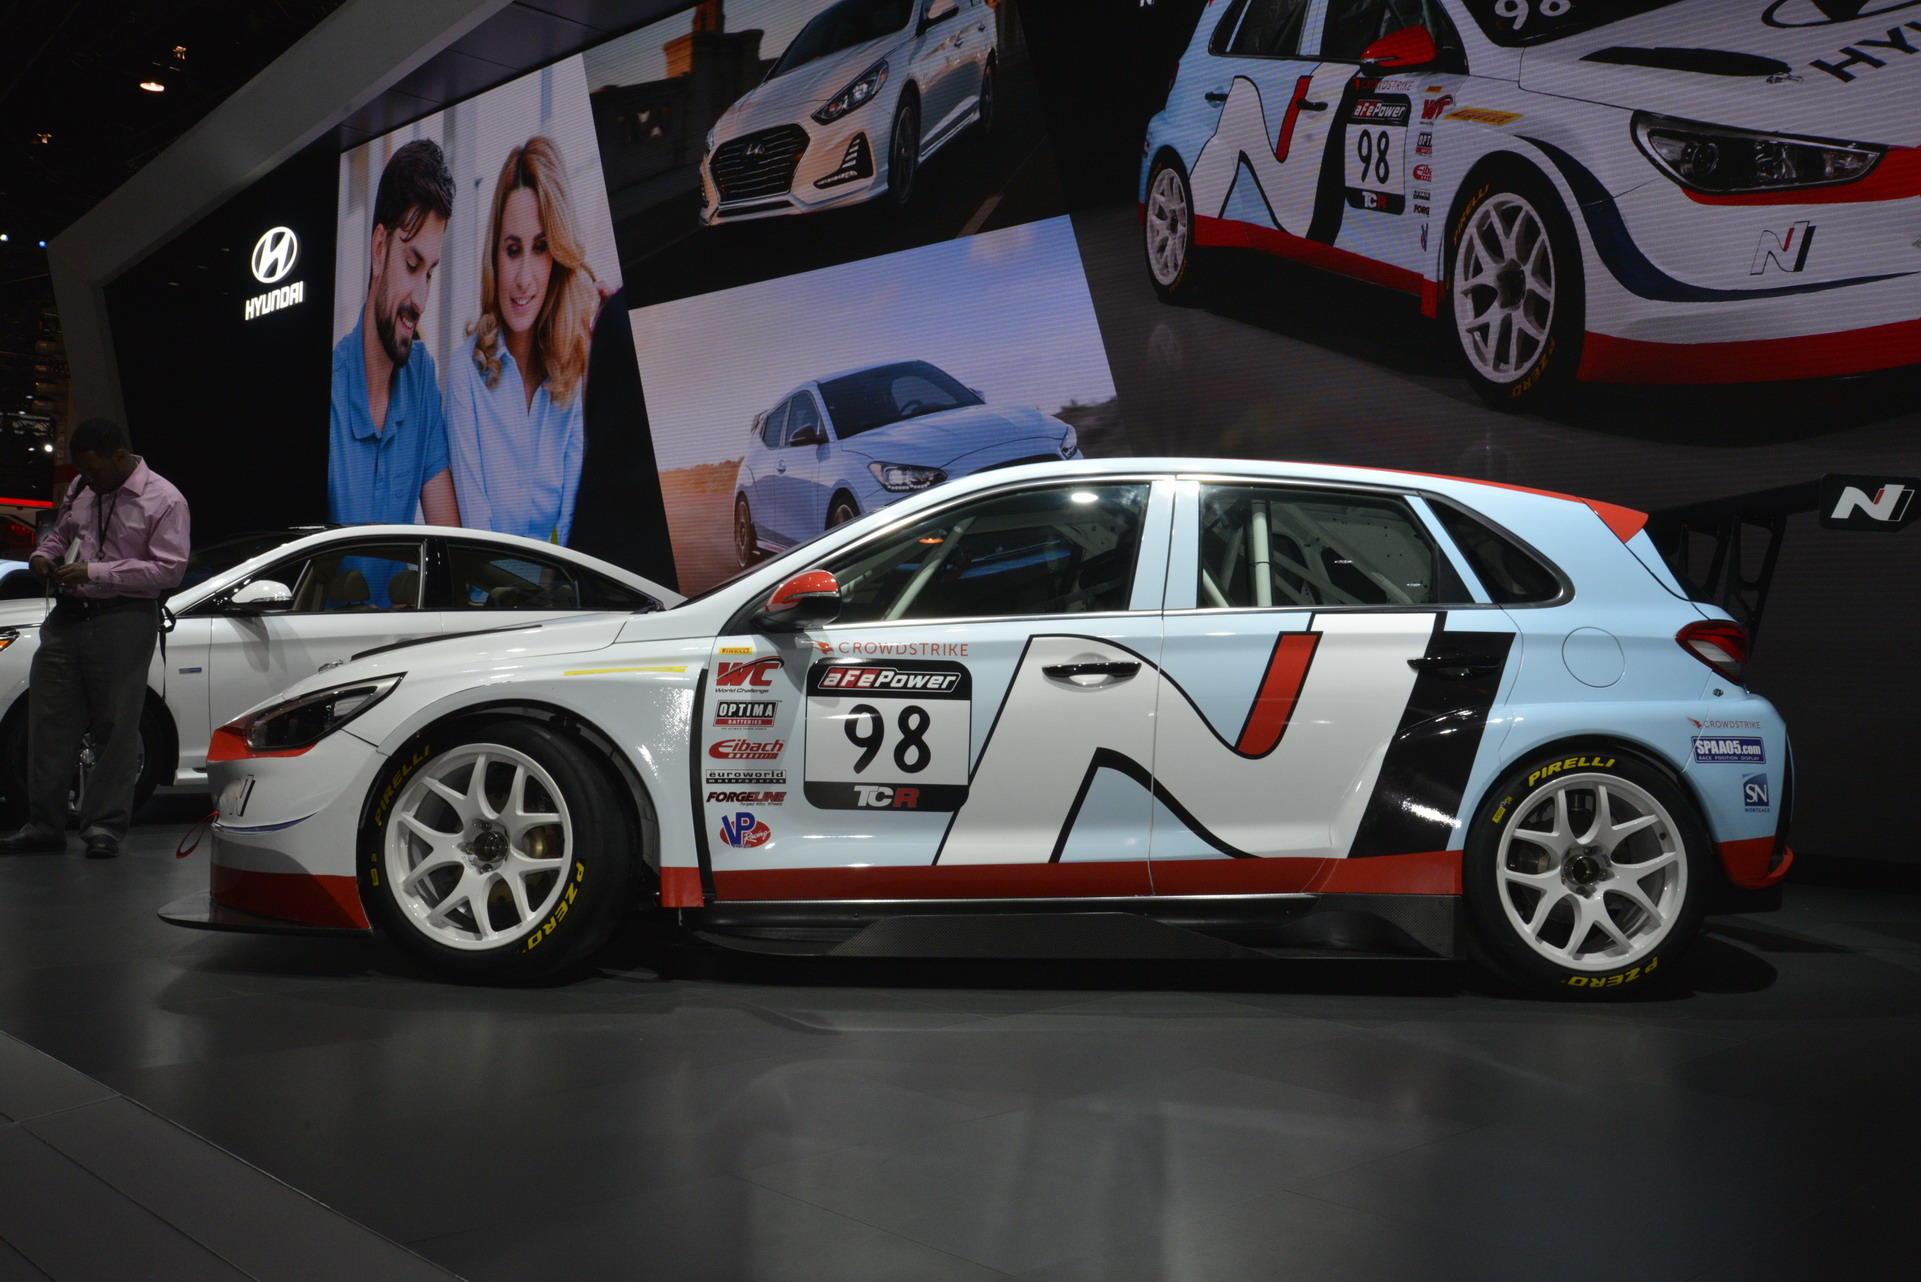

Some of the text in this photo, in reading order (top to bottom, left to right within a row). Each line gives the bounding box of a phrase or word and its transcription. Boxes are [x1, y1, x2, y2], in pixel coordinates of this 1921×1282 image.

[1357, 128, 1390, 185] 98
[245, 281, 304, 321] HYUNDAI
[838, 641, 970, 657] CROWDSTRIKE
[716, 656, 784, 687] WC
[736, 687, 770, 695] Challenge
[719, 702, 774, 717] OPTIMA
[1704, 720, 1761, 729] CROWDSTRIKE
[708, 738, 785, 760] Eibach
[844, 703, 932, 775] 98
[373, 744, 431, 827] PIRELLI
[1528, 756, 1616, 788] PIRELLI
[706, 792, 787, 803] FORGELINE
[853, 785, 920, 808] TCR
[1745, 783, 1768, 803] SN
[721, 811, 756, 848] VP
[743, 829, 771, 844] Racing
[527, 861, 585, 952] P ZERO
[1566, 956, 1659, 988] P ZERO
